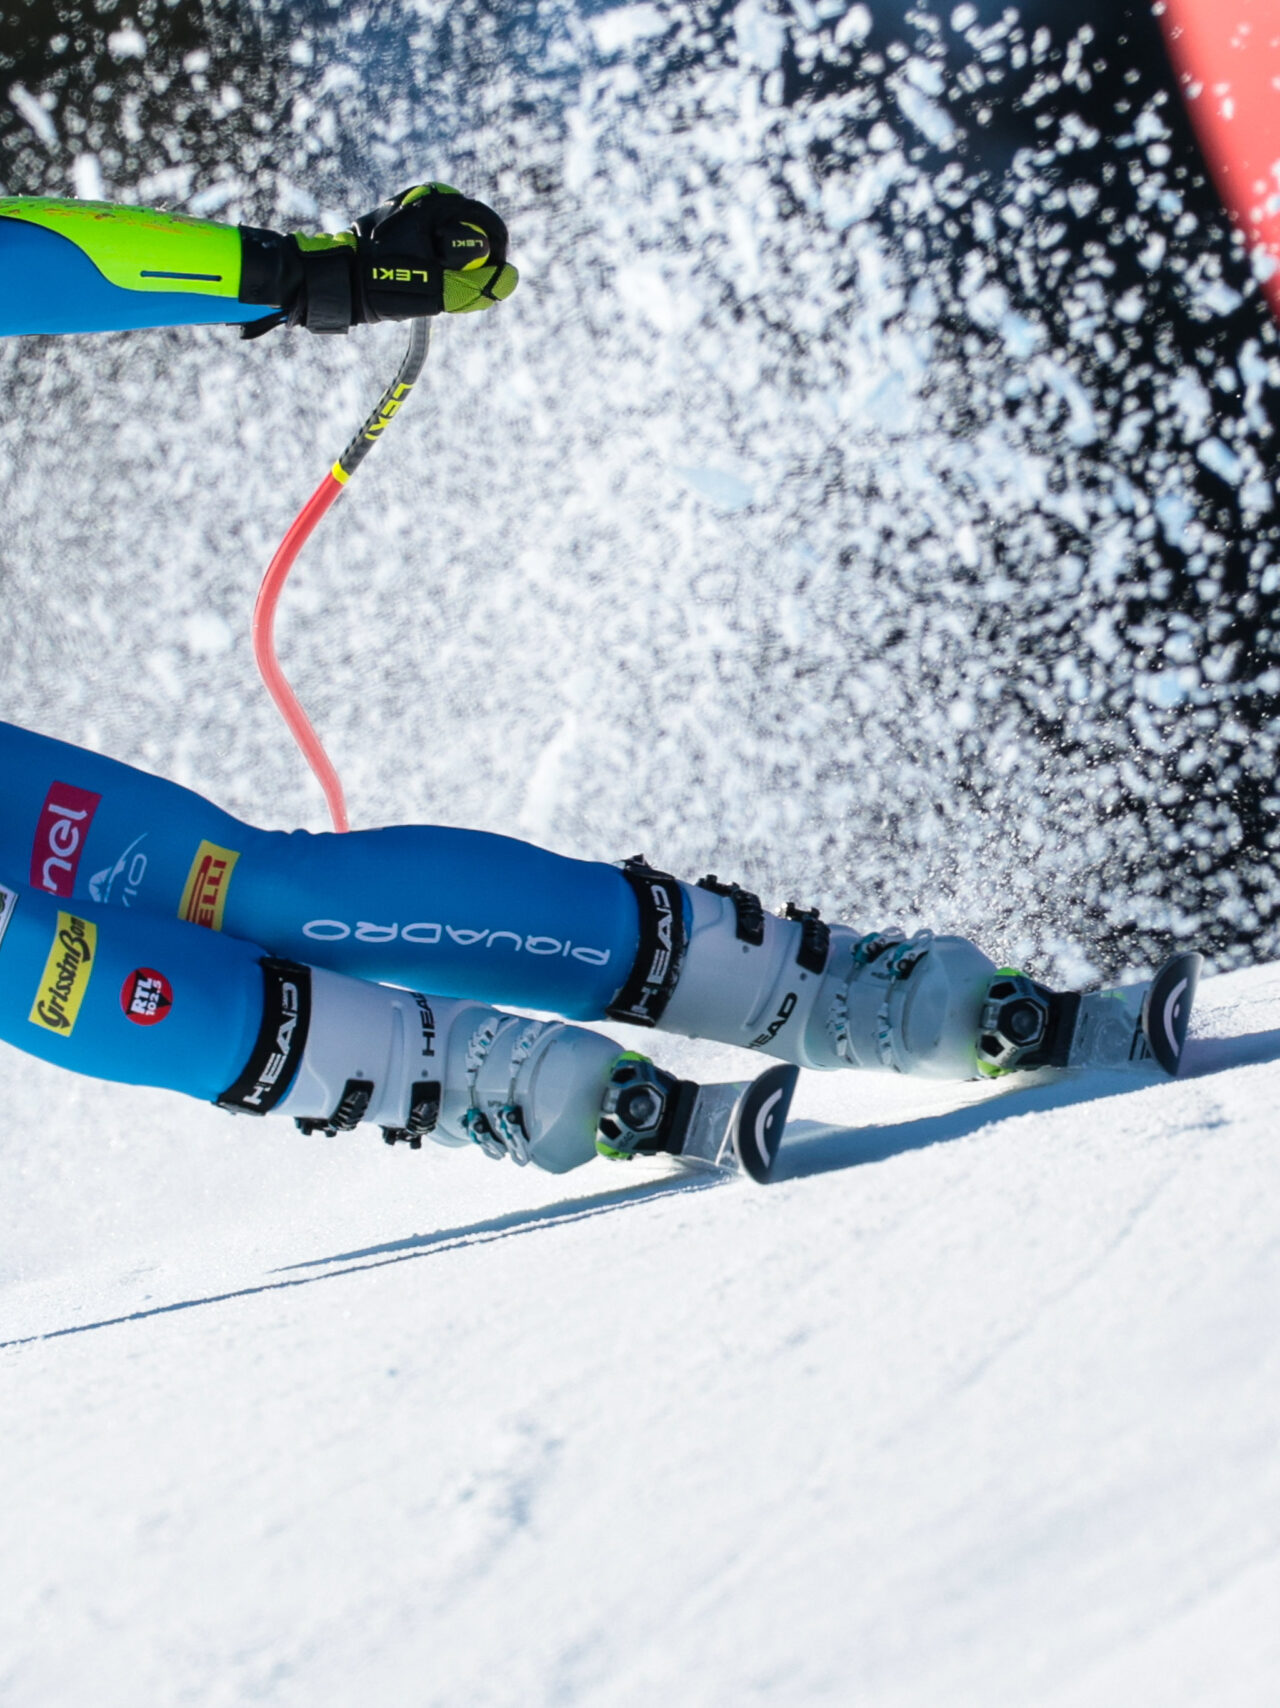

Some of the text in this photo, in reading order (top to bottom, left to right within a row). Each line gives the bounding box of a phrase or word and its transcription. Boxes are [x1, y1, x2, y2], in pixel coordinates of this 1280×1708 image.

[451, 238, 484, 248] LEKI
[372, 267, 429, 283] LEKI
[364, 383, 417, 441] LEKI
[42, 803, 88, 895] nel
[302, 919, 611, 966] PIQUADRO
[630, 884, 674, 1015] HEAD
[130, 976, 154, 1015] RTL
[145, 979, 163, 1016] 102.5
[242, 981, 298, 1106] HEAD
